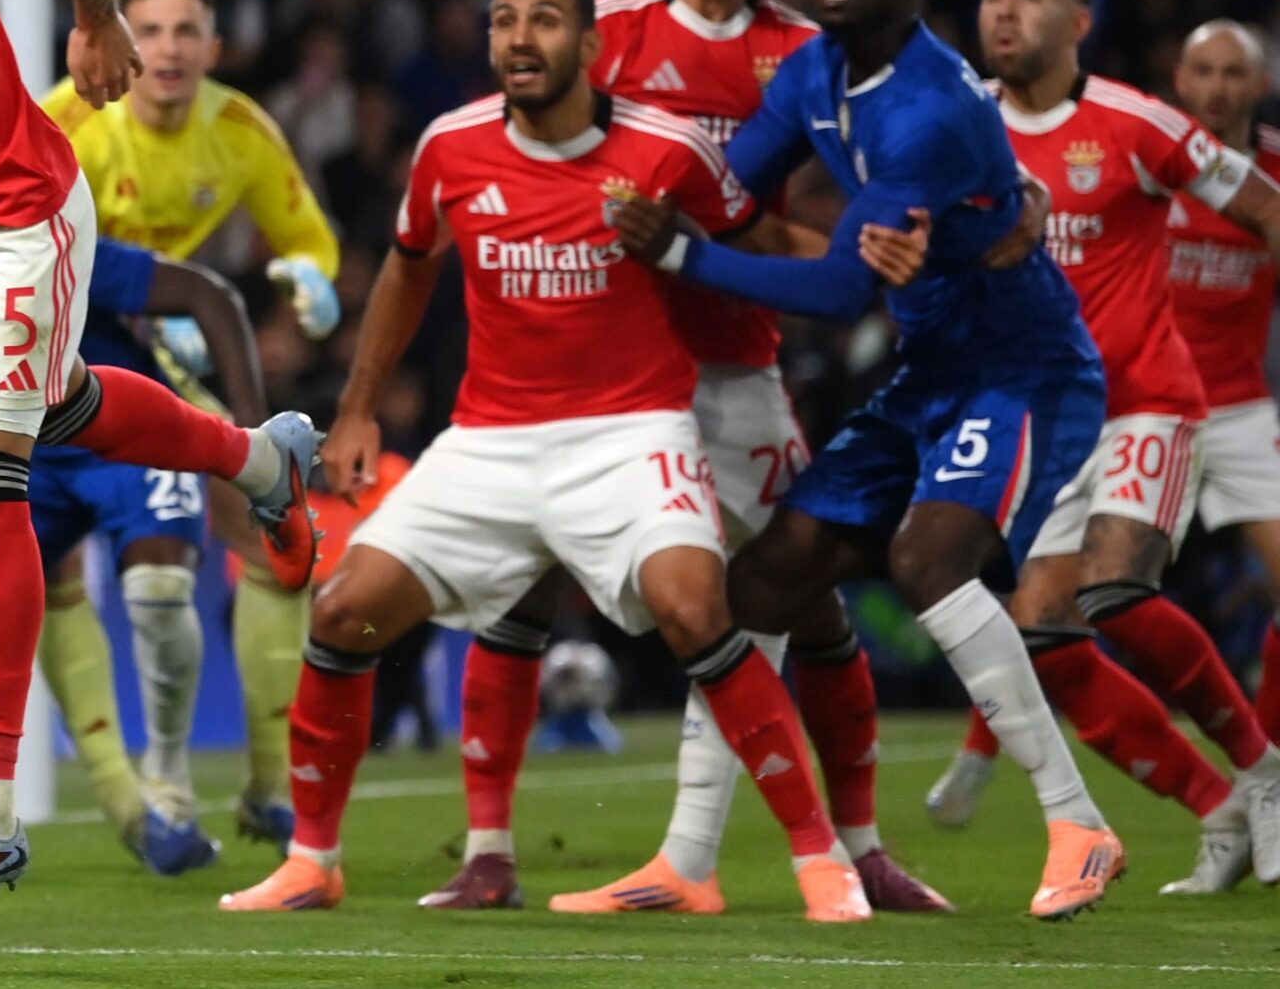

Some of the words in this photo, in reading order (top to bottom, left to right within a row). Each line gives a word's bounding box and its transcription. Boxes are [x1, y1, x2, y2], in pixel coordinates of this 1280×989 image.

[477, 235, 625, 271] Emirates
[500, 271, 532, 299] FLY
[537, 268, 609, 299] BETTER
[3, 286, 38, 356] 5
[950, 418, 992, 468] 5
[1104, 434, 1167, 480] 30
